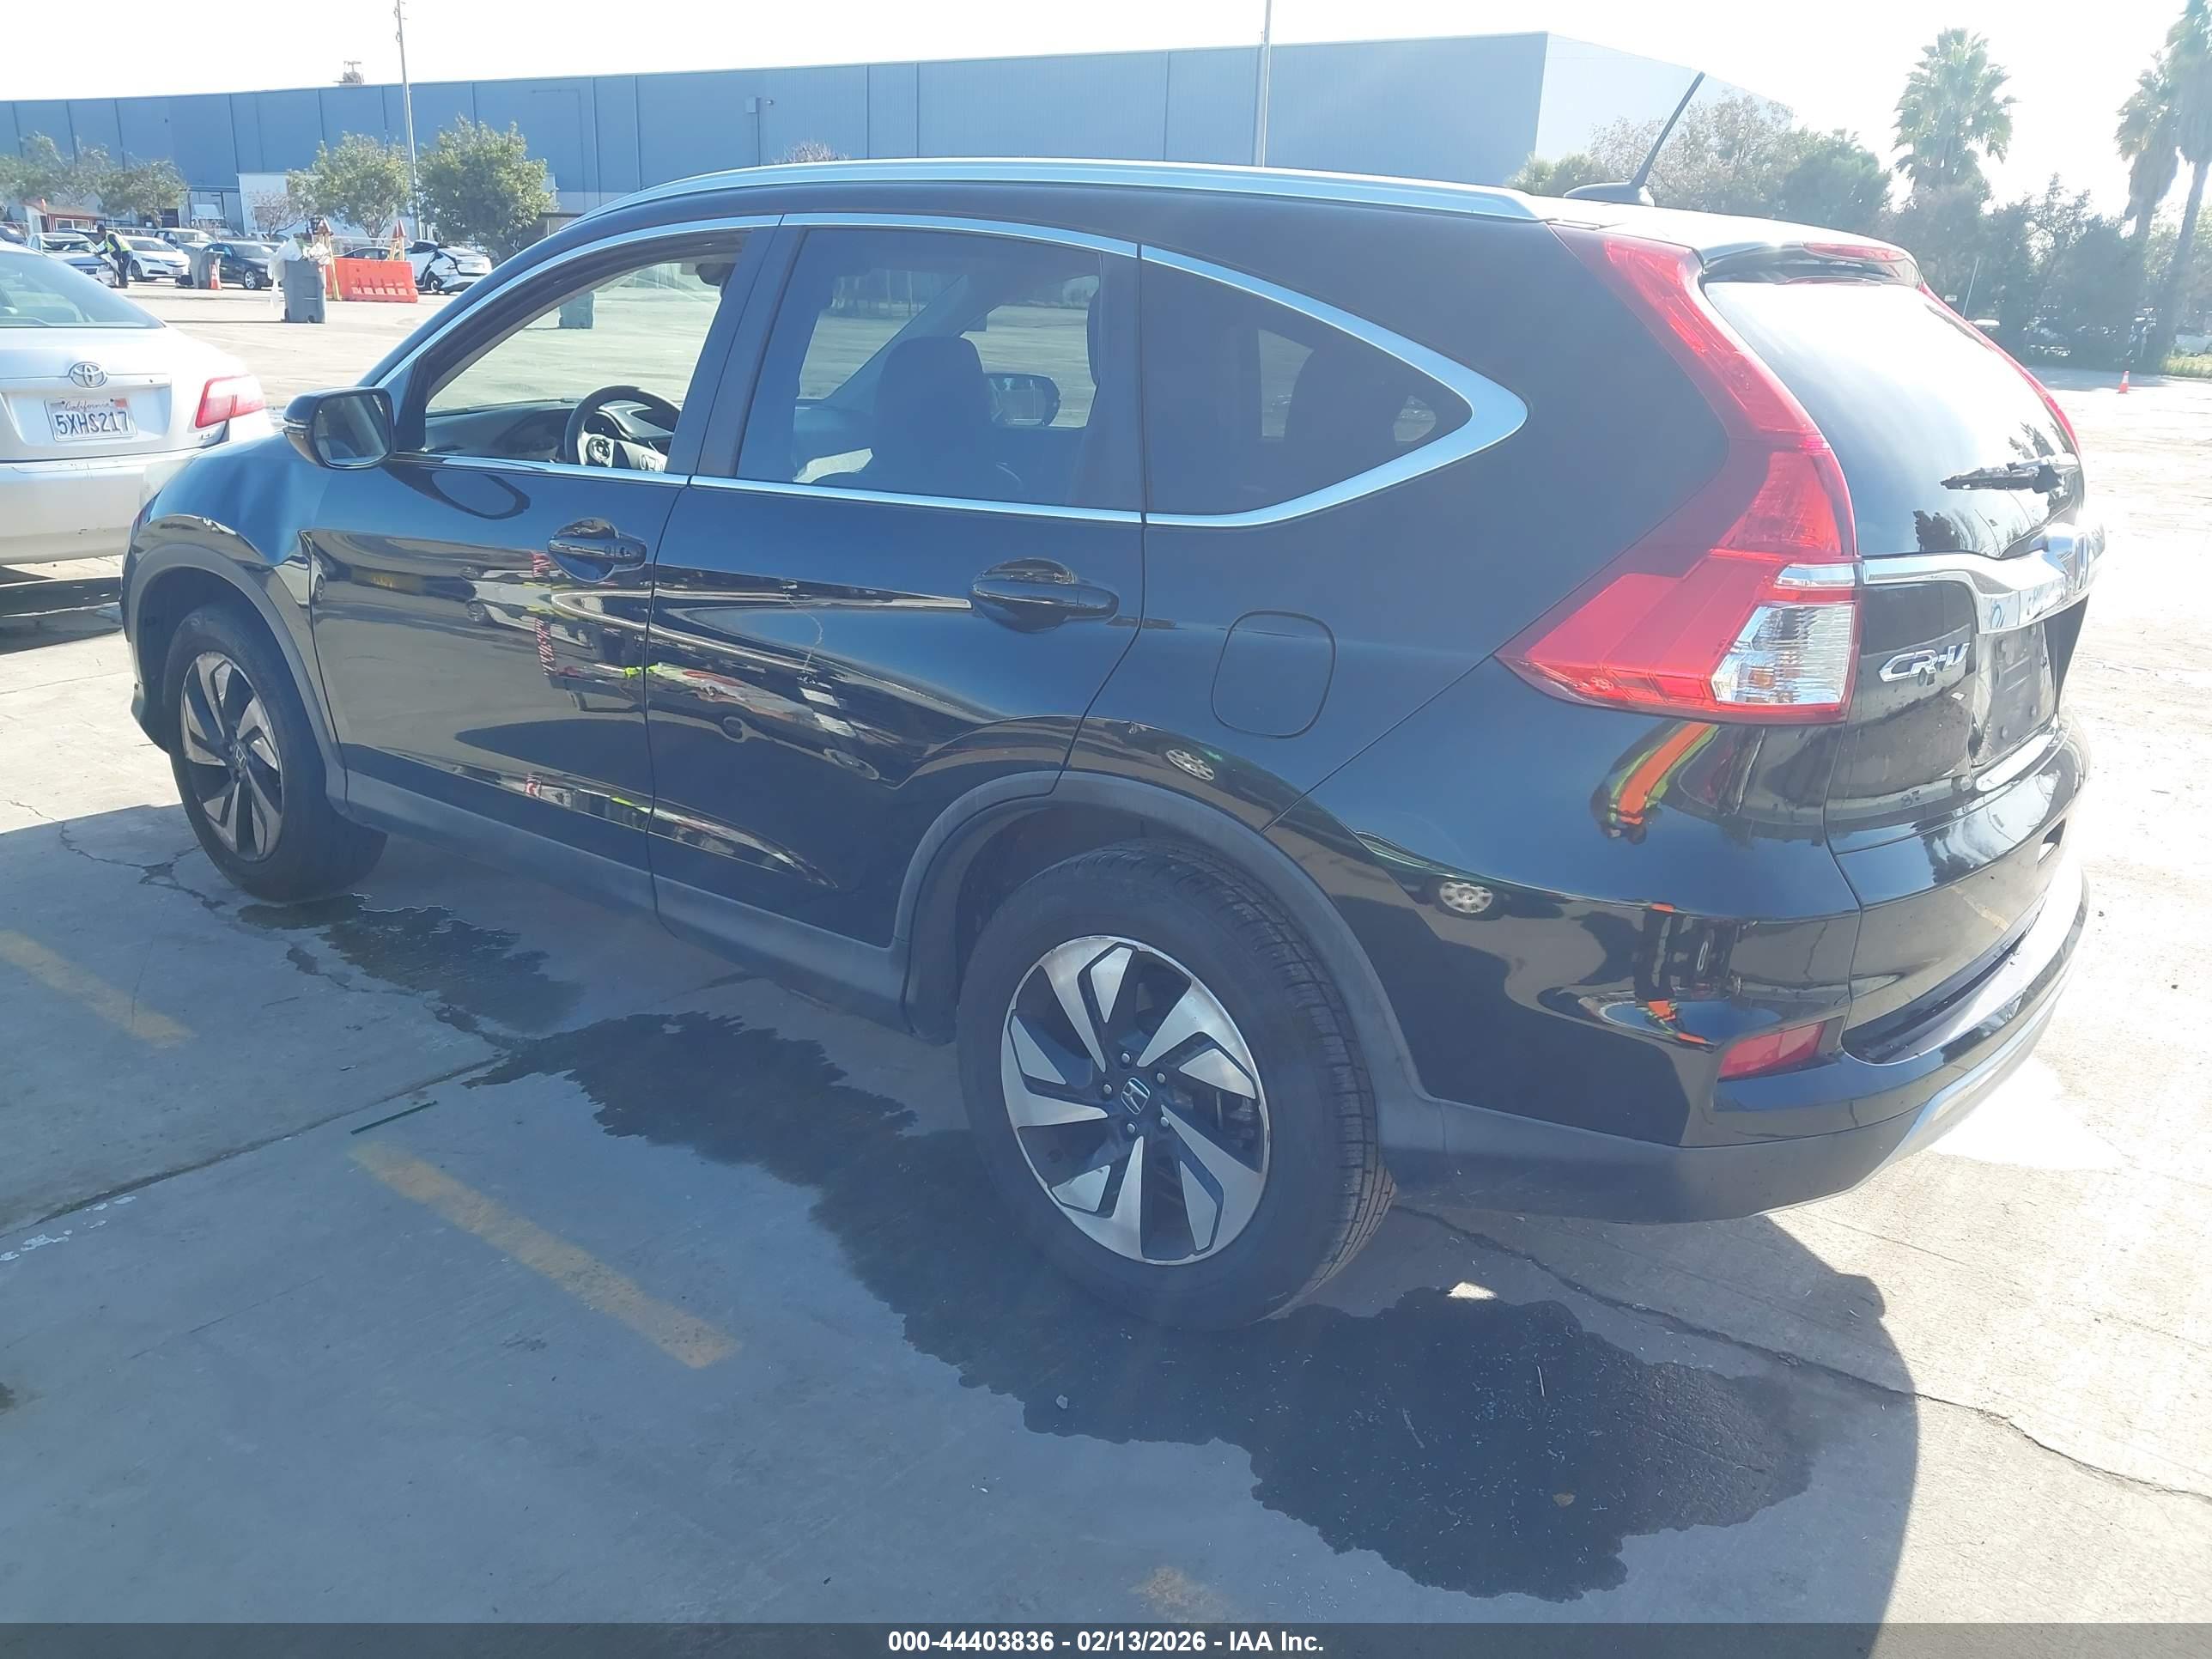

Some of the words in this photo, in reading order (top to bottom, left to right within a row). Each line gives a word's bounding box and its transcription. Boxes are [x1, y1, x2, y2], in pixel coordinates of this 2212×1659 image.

[64, 400, 111, 412] California
[54, 411, 130, 434] 5XHS217
[1878, 642, 1971, 682] CR-V
